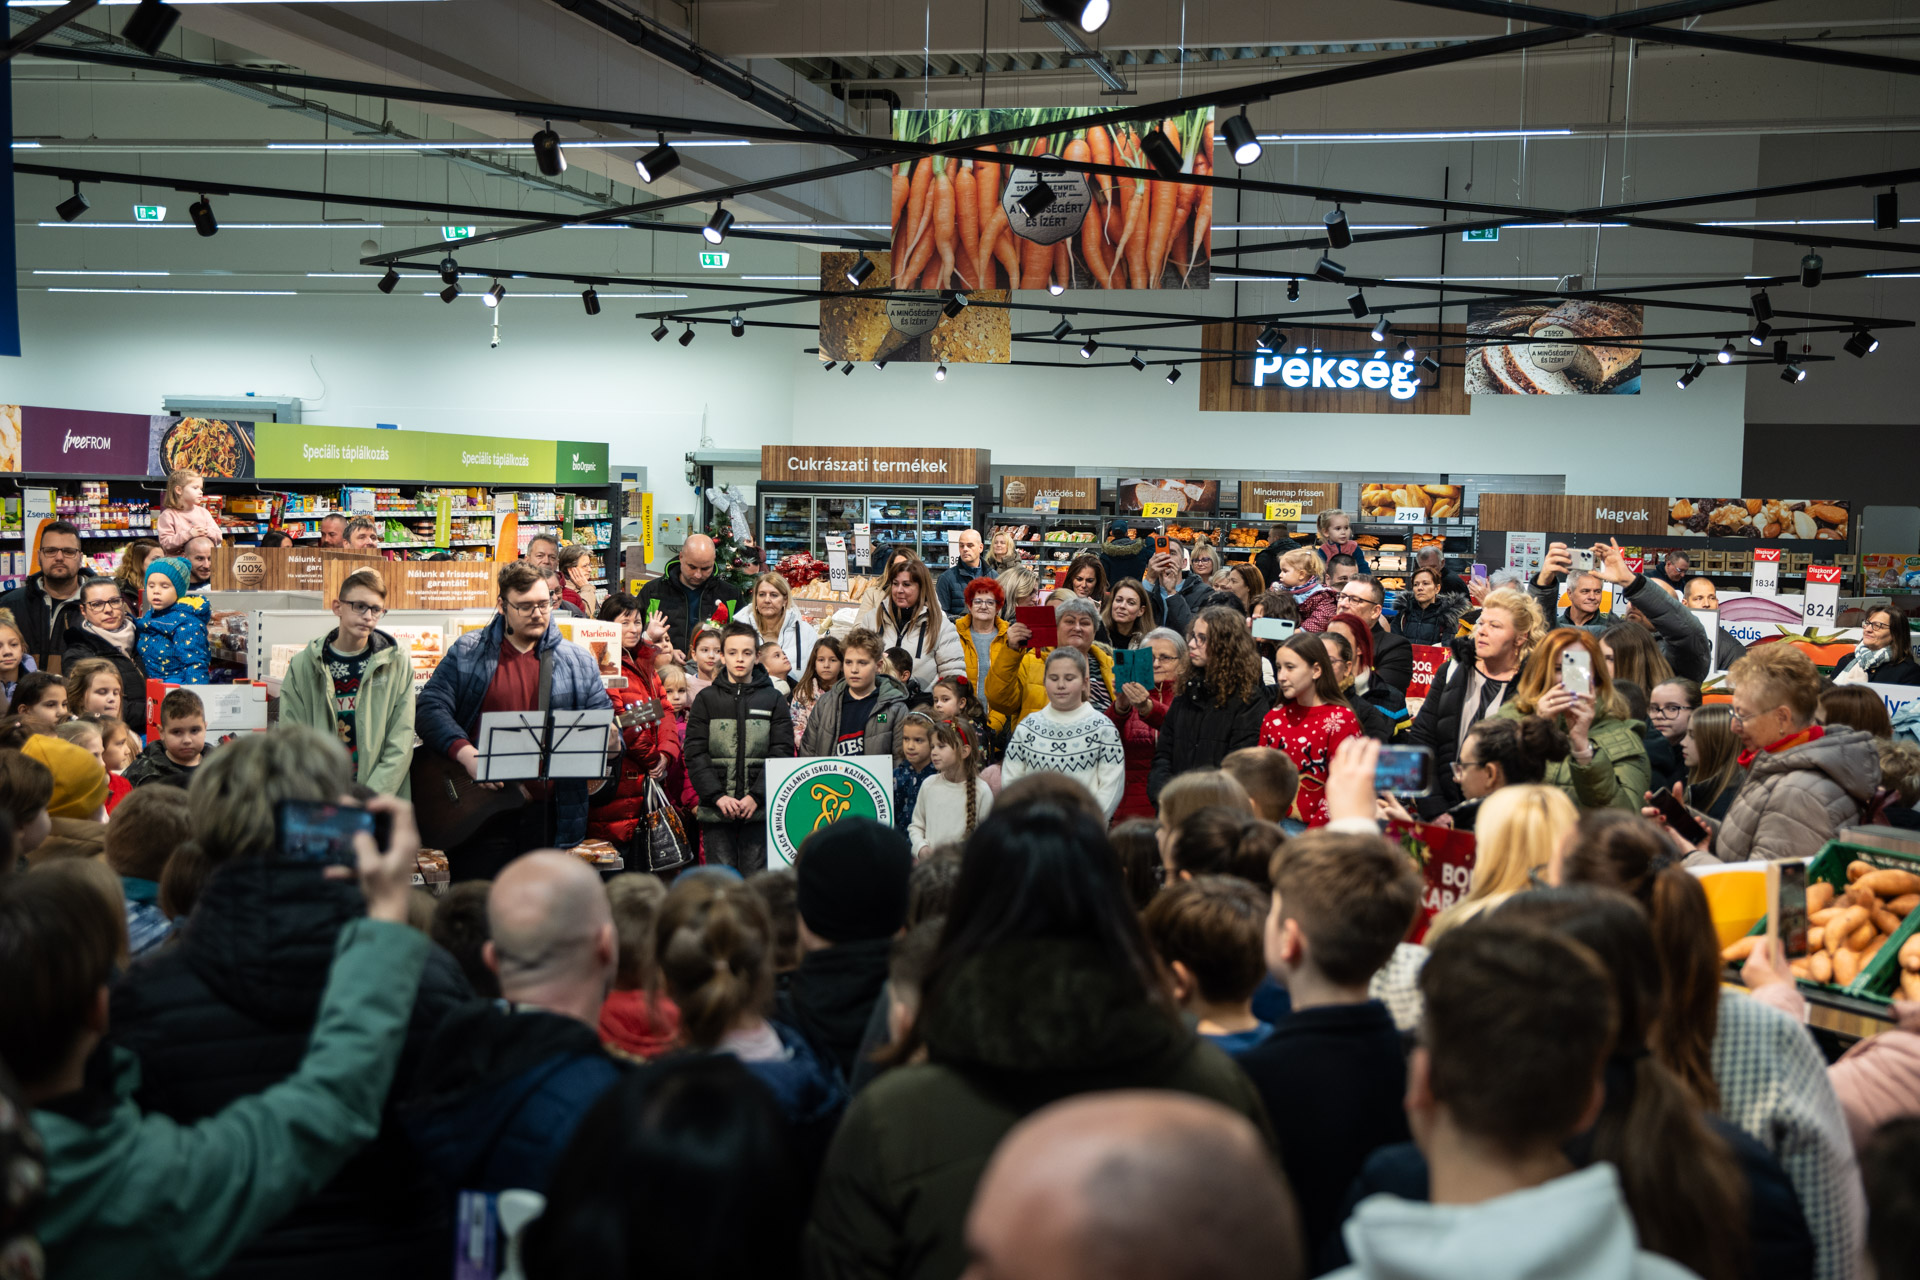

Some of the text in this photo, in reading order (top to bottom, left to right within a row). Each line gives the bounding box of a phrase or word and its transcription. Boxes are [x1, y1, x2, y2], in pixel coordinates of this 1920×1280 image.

[1009, 204, 1017, 214] A
[1040, 215, 1068, 227] ÍZÉRT
[1253, 346, 1417, 400] Pékség
[303, 444, 390, 463] Speciális táplálkozás
[462, 450, 529, 467] Speciális táplálkozás
[787, 456, 948, 473] Cukrászati termékek
[1253, 488, 1324, 498] Mindennap frissen
[26, 510, 55, 519] Zsenge
[1152, 506, 1172, 515] 249
[1275, 508, 1296, 518] 299
[1398, 512, 1418, 520] 219
[1596, 508, 1649, 523] Magvak
[856, 548, 870, 558] 539
[237, 564, 262, 573] 100%
[831, 568, 846, 580] 899
[408, 570, 438, 578] Nálunk
[446, 570, 488, 580] frissesség
[427, 580, 469, 588] garantált!
[1755, 580, 1774, 588] 1834
[1806, 603, 1834, 618] 824
[1722, 626, 1762, 640] édús
[812, 764, 838, 774] ISKOLA
[844, 766, 876, 790] KAZINCZY
[778, 770, 811, 803] ÁLTALÁNOS
[872, 790, 887, 819] FERENC
[778, 833, 798, 860] OLLACK
[1442, 862, 1474, 888] BO
